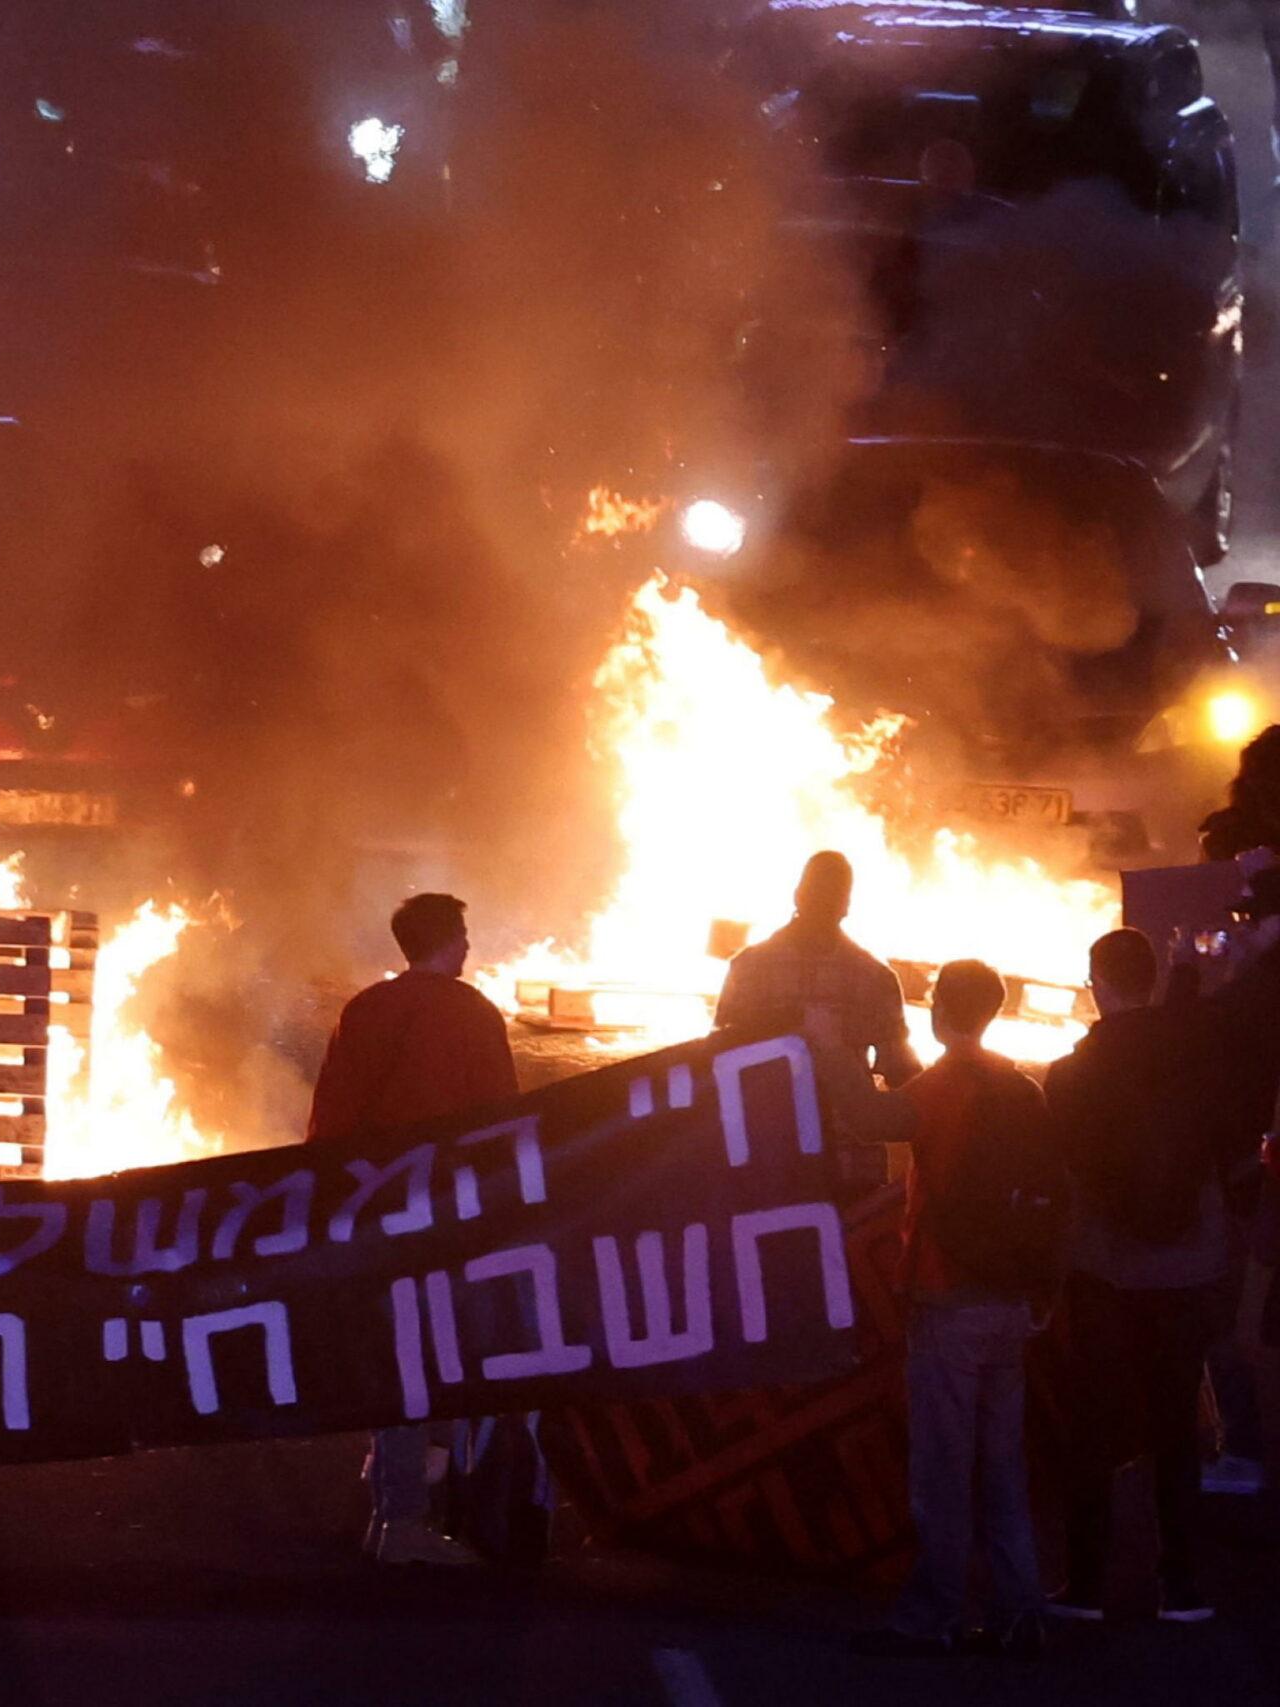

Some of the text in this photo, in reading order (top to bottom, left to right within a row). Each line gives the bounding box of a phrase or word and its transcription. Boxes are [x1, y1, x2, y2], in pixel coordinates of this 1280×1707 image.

[628, 1034, 823, 1168] חיי
[102, 1300, 298, 1416] חיי
[391, 1202, 856, 1420] חשבון
